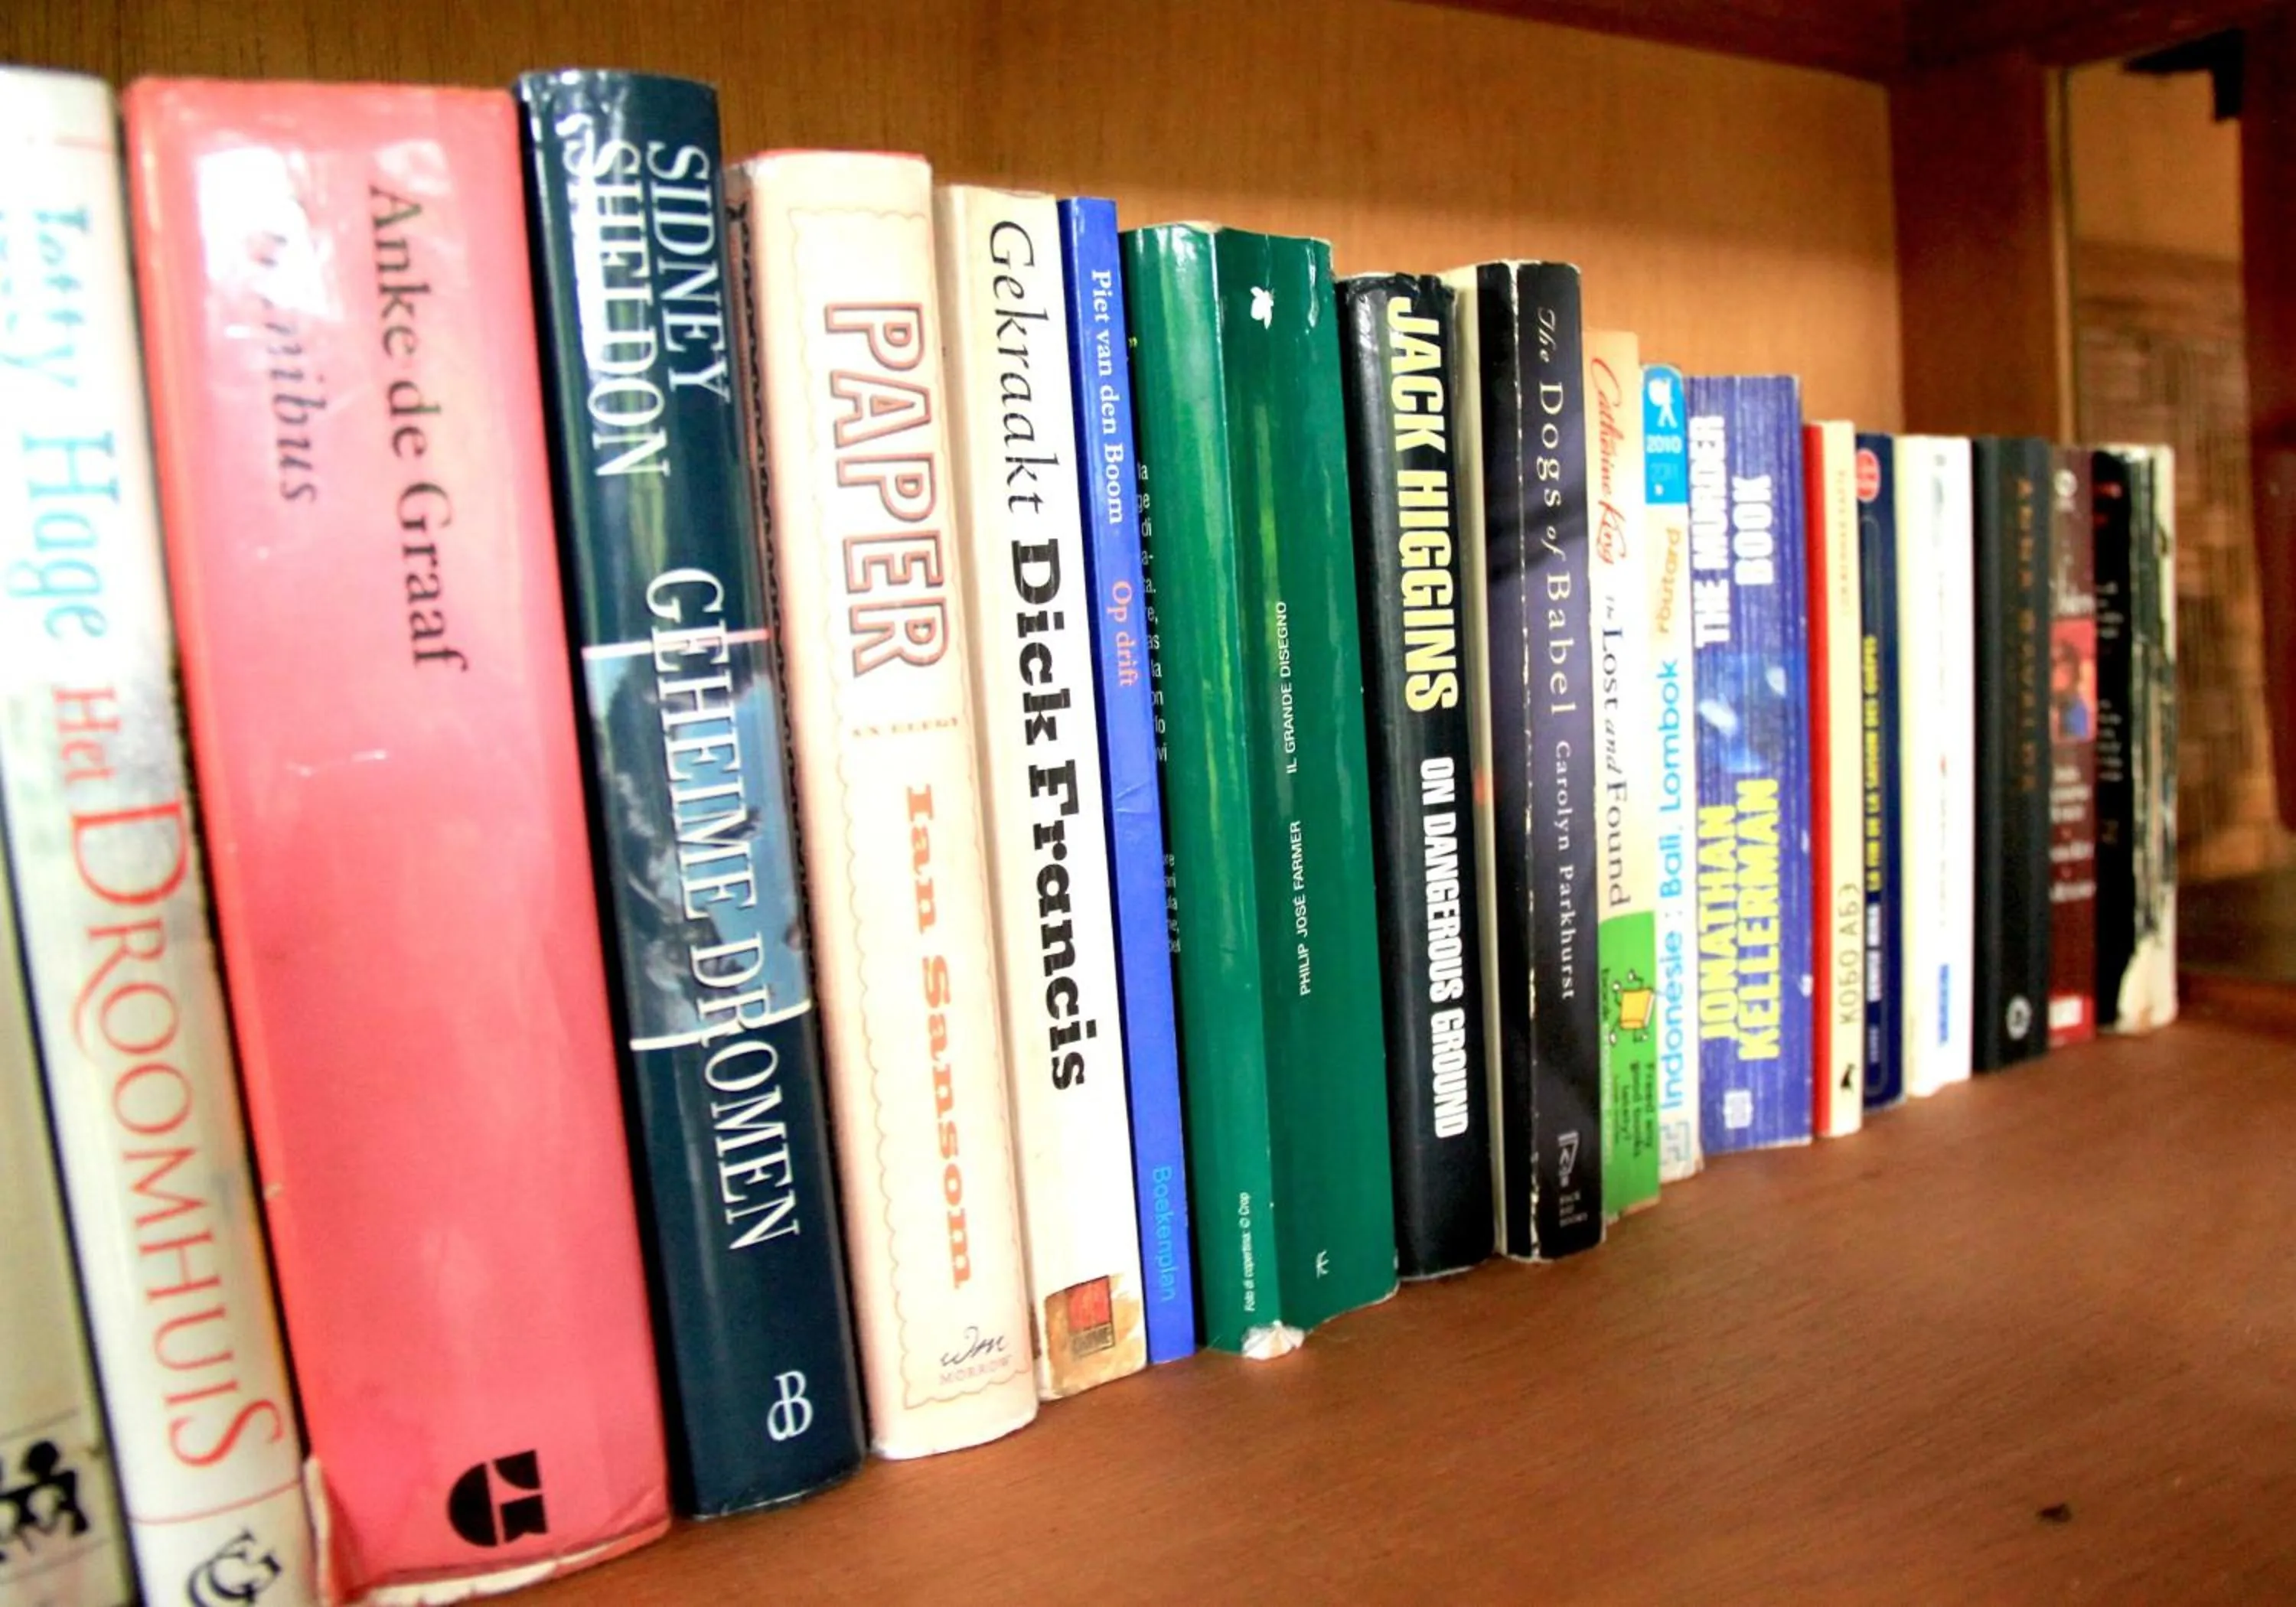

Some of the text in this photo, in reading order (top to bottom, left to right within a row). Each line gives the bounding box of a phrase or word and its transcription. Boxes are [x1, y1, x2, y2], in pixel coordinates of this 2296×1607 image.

[249, 230, 328, 505] nibus
[563, 139, 670, 477] SHELDON
[646, 141, 729, 403] SIDNEY
[7, 429, 119, 641] Hage
[368, 184, 468, 672] Anke de Graaf
[824, 302, 949, 677] PAPER
[1091, 269, 1138, 687] Piet van den Boom Op drift
[1591, 357, 1627, 566] Catherine King
[54, 686, 123, 786] Het
[990, 219, 1097, 1092] Gekraakt Dick Francis
[1275, 601, 1298, 774] IL GRANDE DISEGNO
[1387, 296, 1469, 1139] JACK HIGGINS ON DANGEROUS GROUND
[1536, 307, 1579, 1002] The Dogs of Babel Carolyn Parkhurst
[1602, 627, 1624, 711] Lost
[1605, 717, 1624, 777] and
[1657, 658, 1681, 813] Lombok
[645, 568, 800, 1251] GEHEIME DROMEN
[1290, 820, 1311, 996] PHILIP JOSÉ FARMER
[1606, 777, 1631, 908] Found
[1698, 803, 1738, 1041] JONATHAN
[1735, 778, 1781, 1061] KELLERMAN
[905, 783, 973, 1290] Ian Sansom
[1659, 929, 1684, 1110] Indonesie
[1838, 949, 1861, 1025] КОБО
[68, 798, 284, 1468] DROOMHUIS
[1152, 1165, 1180, 1302] Boekenplan
